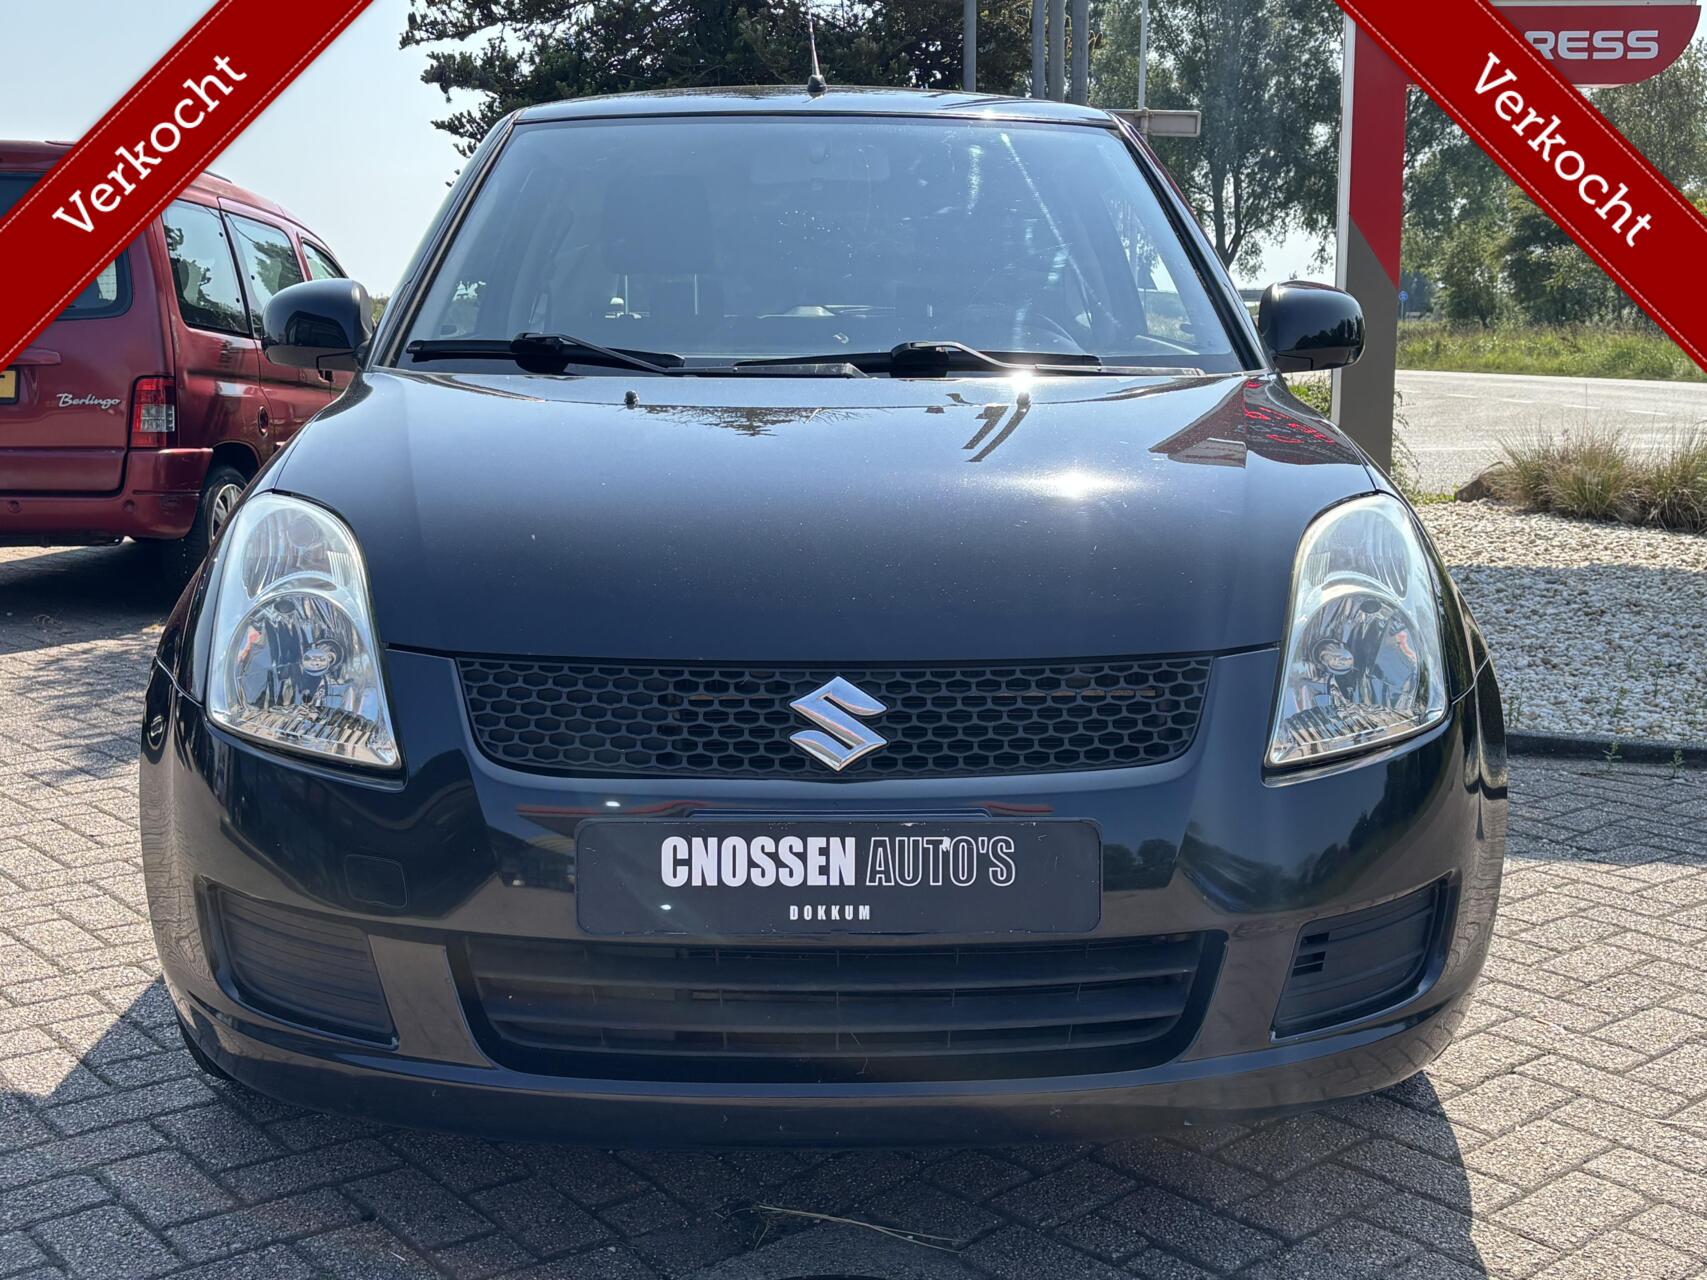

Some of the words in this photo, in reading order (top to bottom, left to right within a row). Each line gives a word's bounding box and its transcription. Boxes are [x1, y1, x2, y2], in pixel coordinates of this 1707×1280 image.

[56, 393, 121, 409] Berlingo
[661, 836, 856, 887] CNOSSEN
[866, 836, 1016, 887] AUTO'S
[789, 905, 870, 921] DOKKUM
